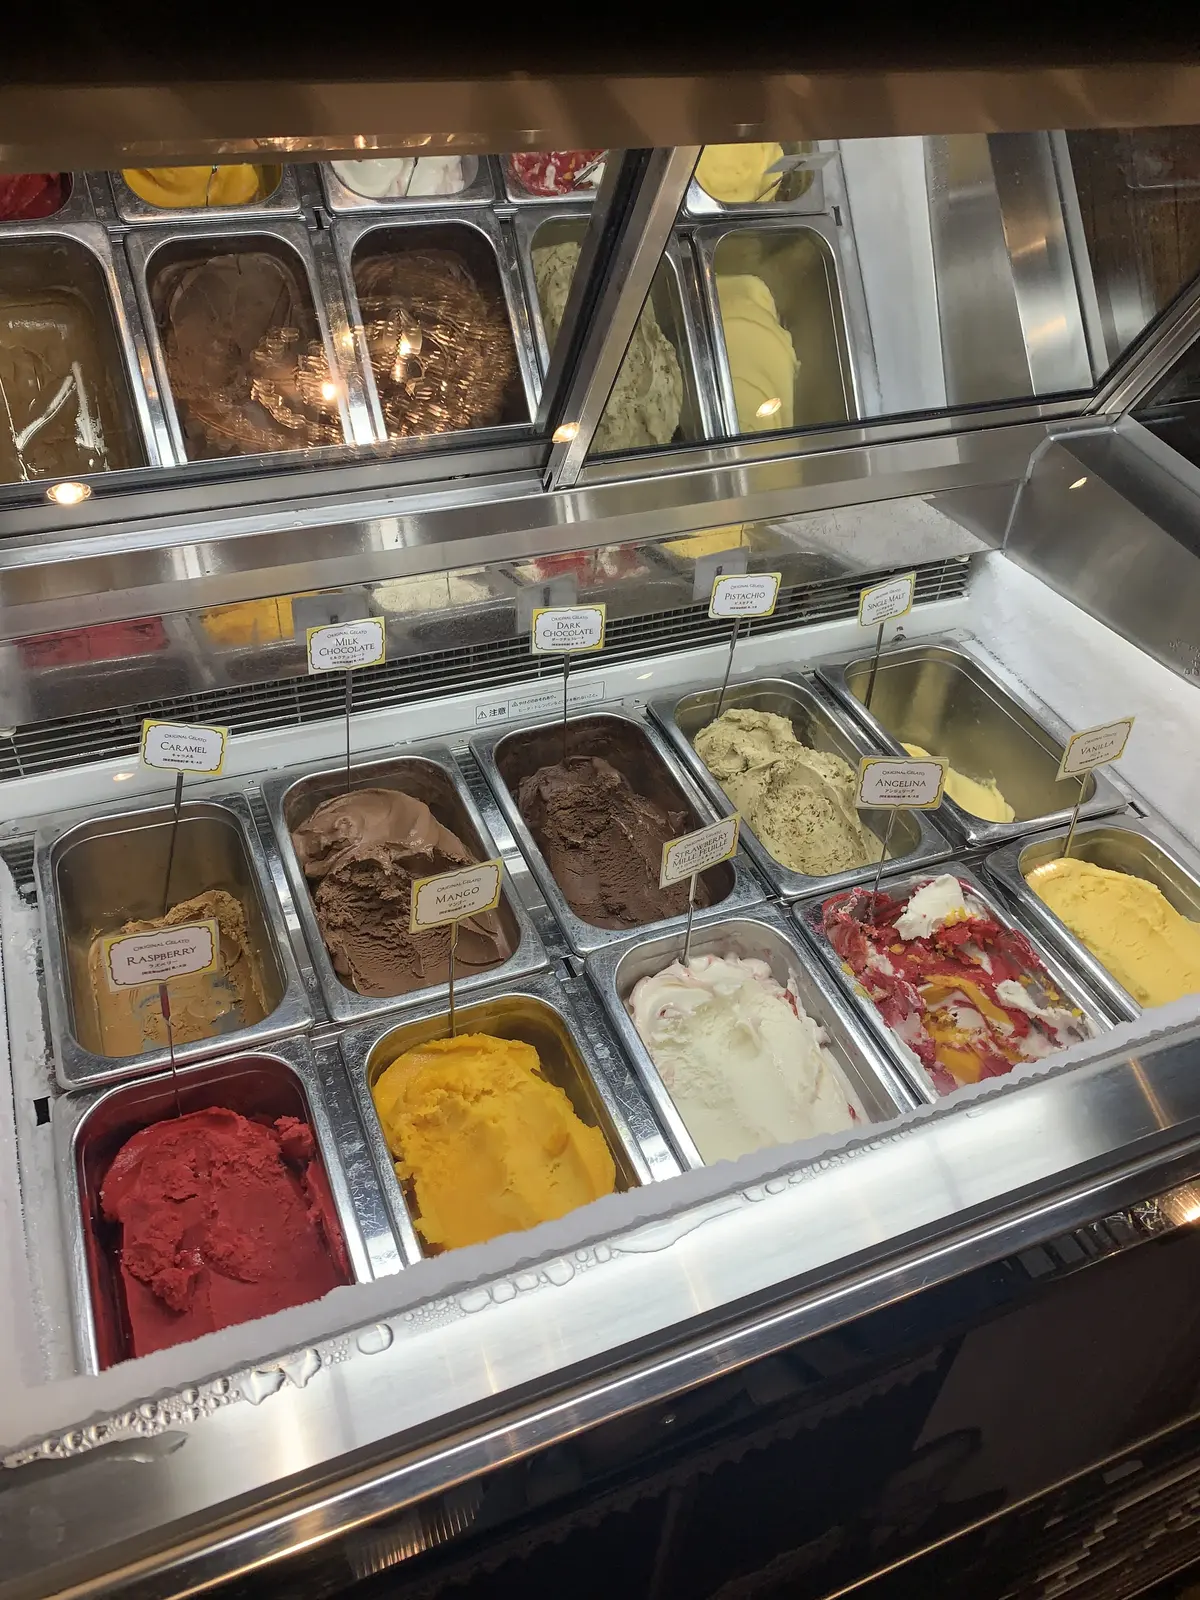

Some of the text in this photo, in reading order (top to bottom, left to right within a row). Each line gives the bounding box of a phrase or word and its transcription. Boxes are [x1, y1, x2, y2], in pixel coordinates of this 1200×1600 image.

[724, 592, 766, 600] PISTACHIO
[866, 599, 888, 611] SINGLE
[888, 592, 906, 602] MALT
[556, 622, 580, 630] DARK
[542, 628, 594, 638] CHOCOLATE
[335, 638, 358, 646] MILK
[318, 642, 375, 656] CHOCOLATE
[488, 706, 507, 718] 注意
[160, 742, 207, 754] CARAMEL
[1080, 740, 1114, 755] VANILLA
[875, 778, 927, 788] ANGELINA
[674, 831, 729, 861] STRAWBERRY
[672, 852, 697, 868] MILLE
[699, 839, 728, 857] FEUILLE
[435, 886, 480, 904] MANGO
[126, 946, 197, 966] RASPBERRY
